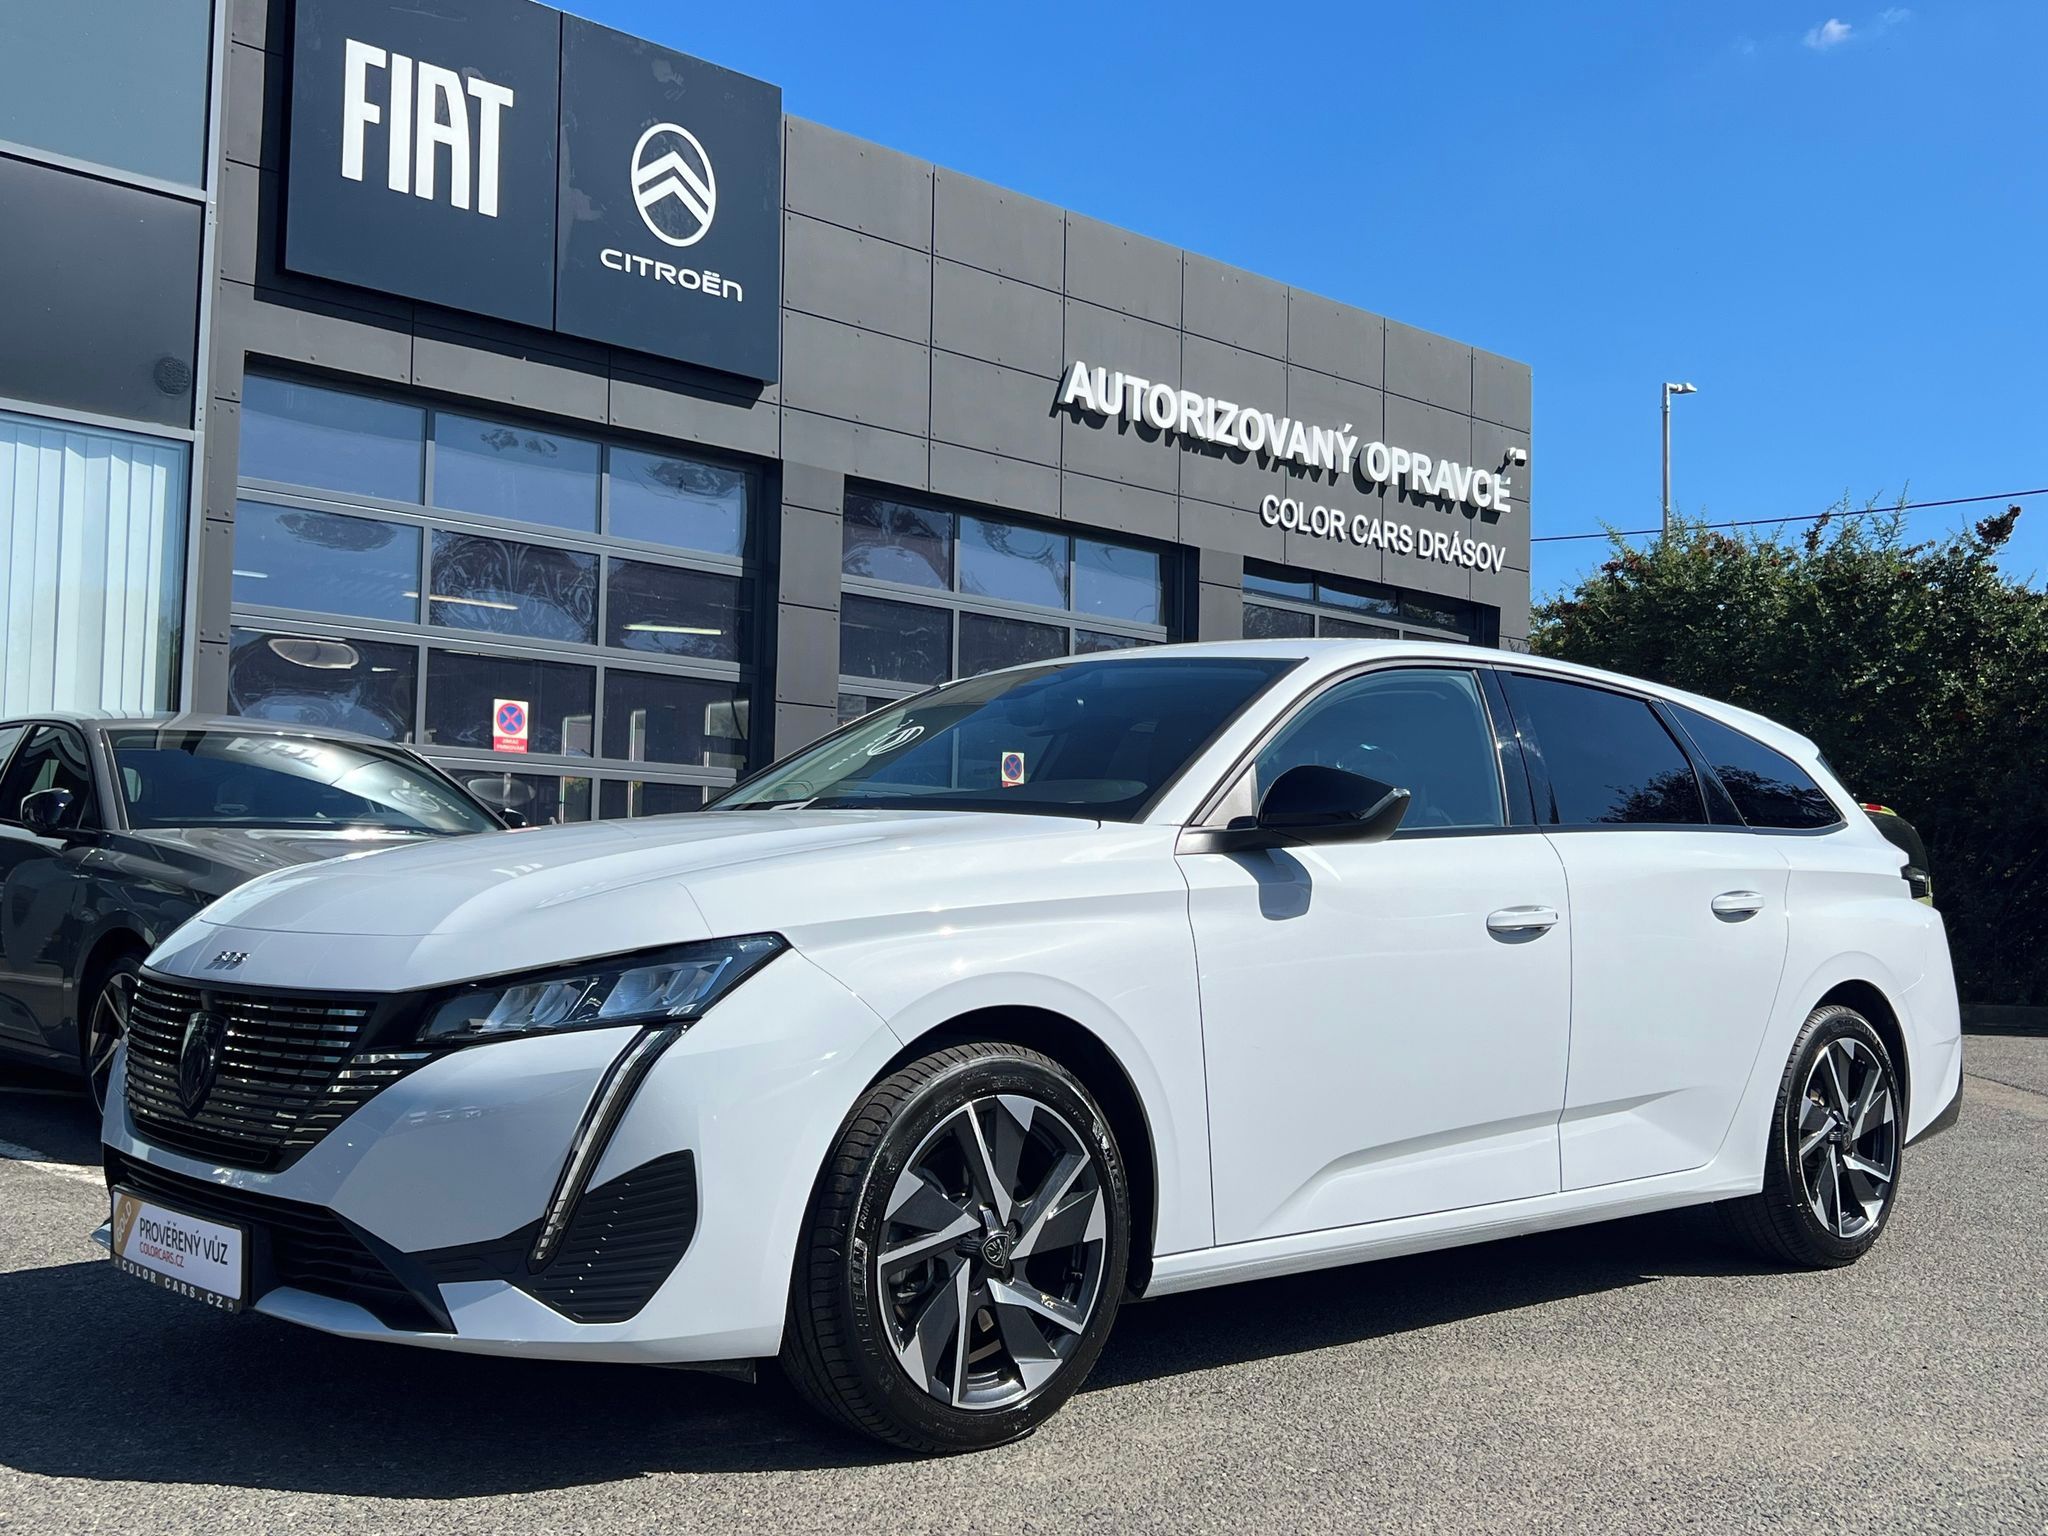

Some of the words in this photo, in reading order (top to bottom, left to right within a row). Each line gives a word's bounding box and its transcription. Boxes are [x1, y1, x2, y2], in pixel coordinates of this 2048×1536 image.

[341, 38, 514, 218] FIAT
[1063, 360, 1359, 474] AUTORIZOVANÝ
[1362, 441, 1512, 513] OPRAVCÉ
[1262, 494, 1346, 541] COLOR
[1351, 513, 1414, 554] CARS
[1418, 527, 1507, 573] DRÁSOV
[116, 1200, 133, 1242] GOLD
[139, 1217, 202, 1257] PROVĚŘENÝ
[203, 1234, 228, 1265] VŮZ
[139, 1241, 185, 1268] COLORCARS.CZ
[122, 1260, 157, 1283] COLOR
[164, 1277, 223, 1309] CARS.CZ
